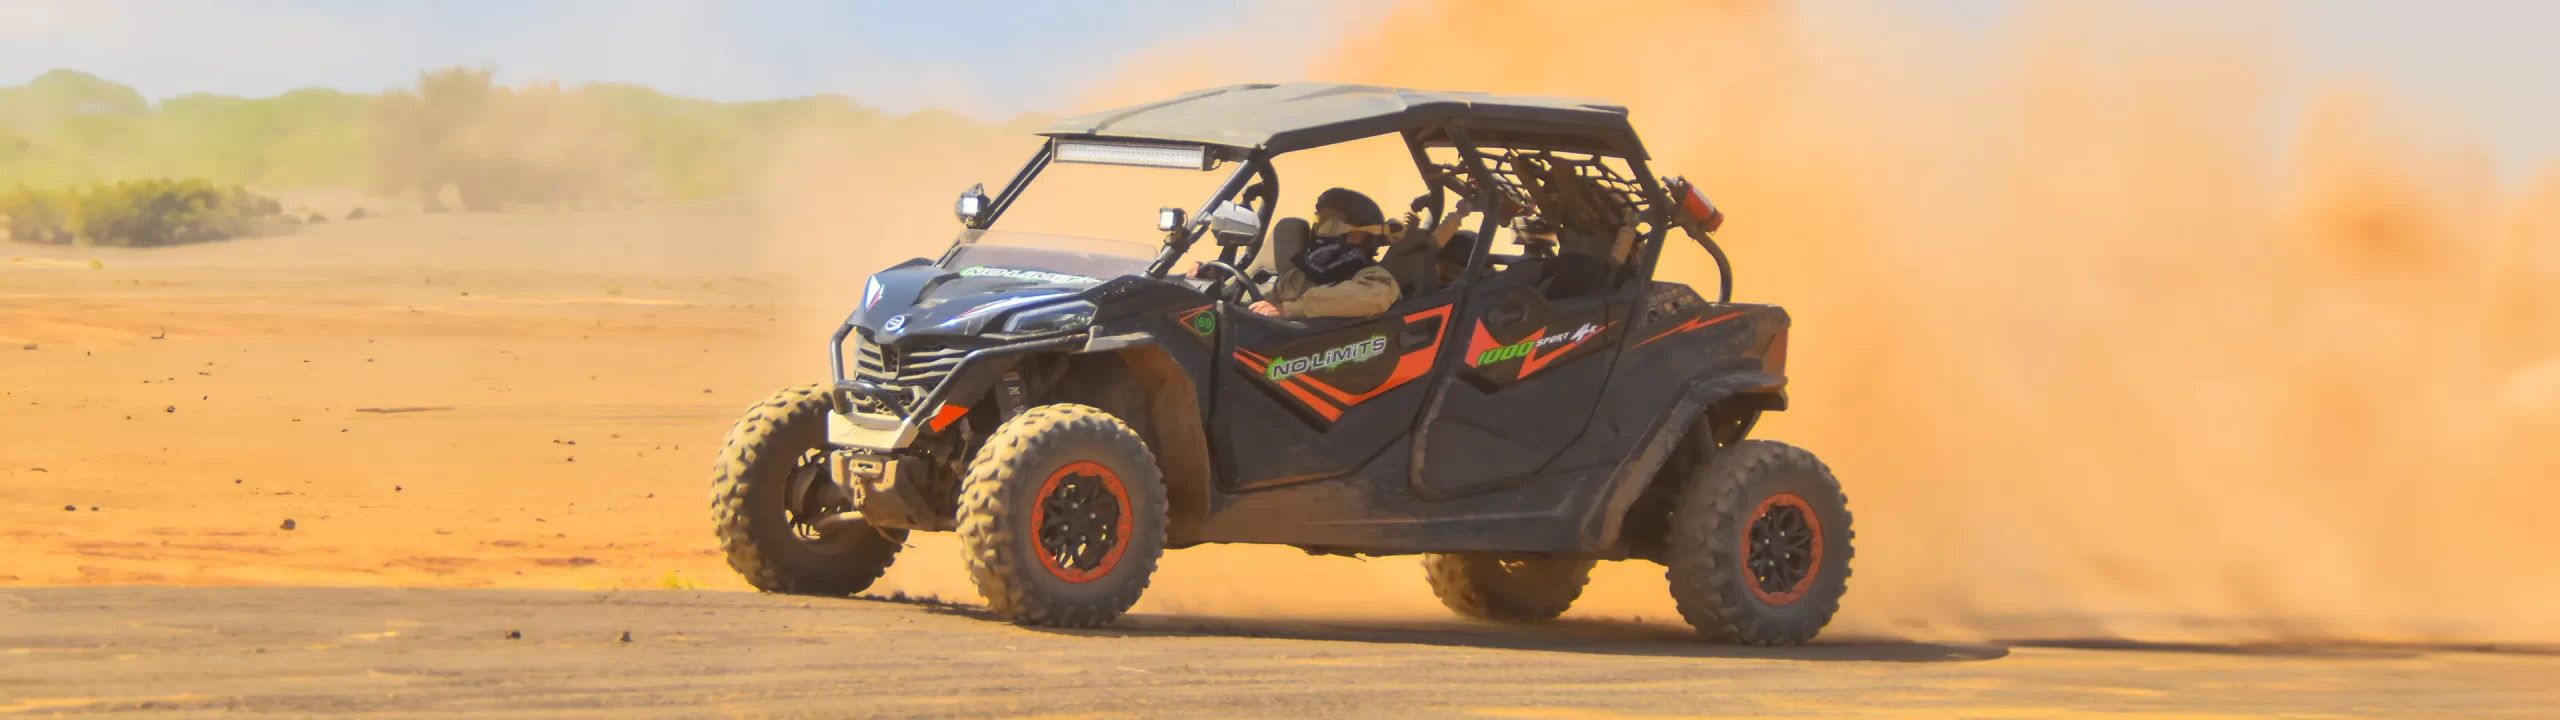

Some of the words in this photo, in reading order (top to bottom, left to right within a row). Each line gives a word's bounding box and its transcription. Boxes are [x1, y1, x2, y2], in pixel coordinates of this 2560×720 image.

[1198, 316, 1212, 329] 69
[1477, 340, 1535, 366] 1000
[1535, 331, 1571, 347] SPORT
